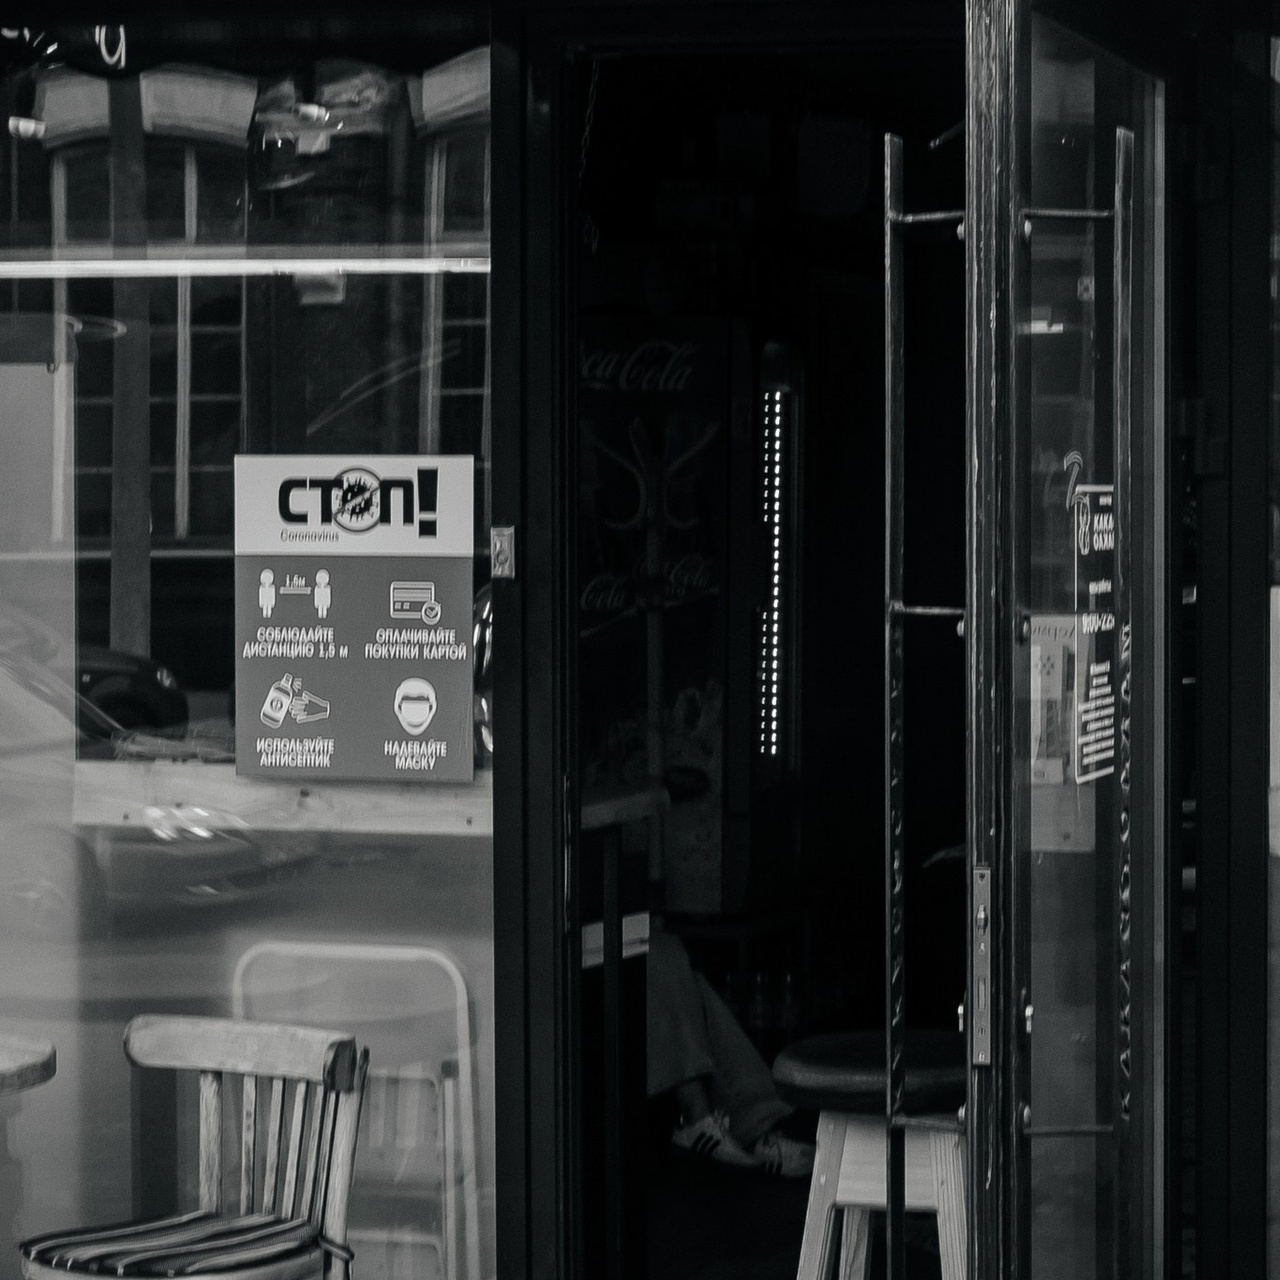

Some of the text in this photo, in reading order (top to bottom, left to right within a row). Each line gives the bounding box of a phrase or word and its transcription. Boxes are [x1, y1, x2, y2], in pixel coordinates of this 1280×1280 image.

[280, 528, 340, 542] Coronavirus
[256, 625, 334, 642] СОБЛЮДАЙТЕ
[376, 627, 456, 644] ОПЛАЧИВАЙТЕ
[243, 641, 314, 659] ДИСТАНЦИЮ
[365, 642, 467, 661] ПОКУПКИ КАРТОЙ
[256, 737, 335, 755] ИСПОЛЬЗУЙТЕ
[384, 740, 447, 757] НАДЕВАЙТЕ
[259, 752, 331, 768] АНТИСЕПТИК
[395, 755, 436, 770] МАСКУ
